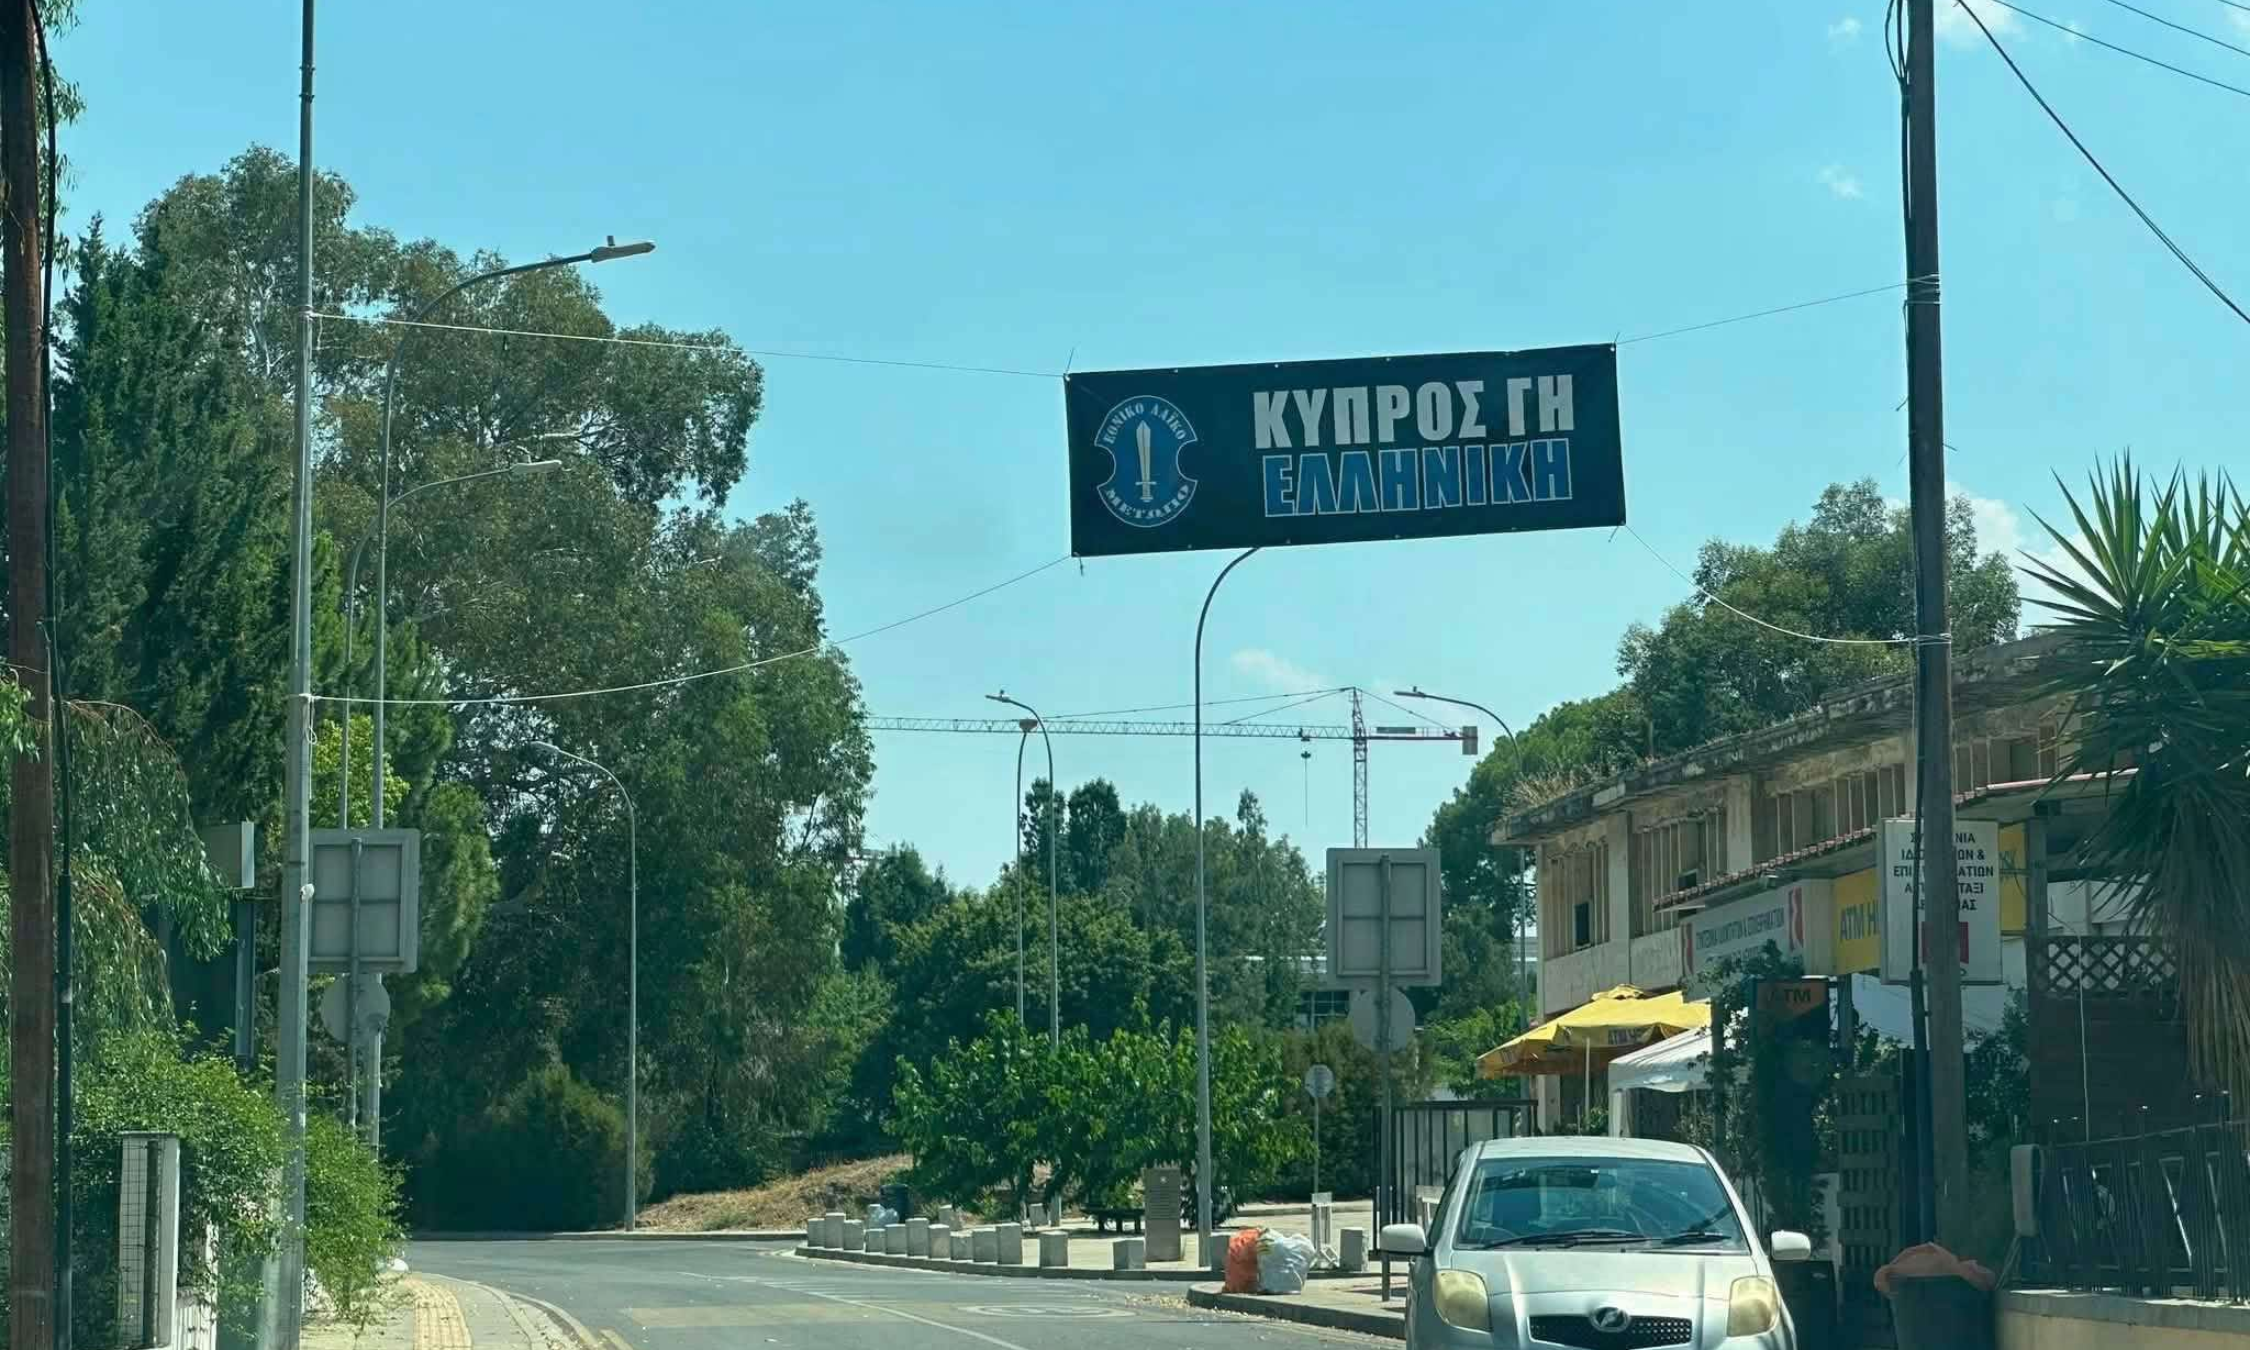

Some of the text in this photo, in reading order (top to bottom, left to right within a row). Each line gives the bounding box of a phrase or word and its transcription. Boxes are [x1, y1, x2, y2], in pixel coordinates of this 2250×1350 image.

[1253, 374, 1575, 449] ΚΥΠΡΟΣ ΓΗ
[1262, 438, 1573, 518] ΕΛΛΗΝΙΚΗ
[1976, 848, 1986, 861] &
